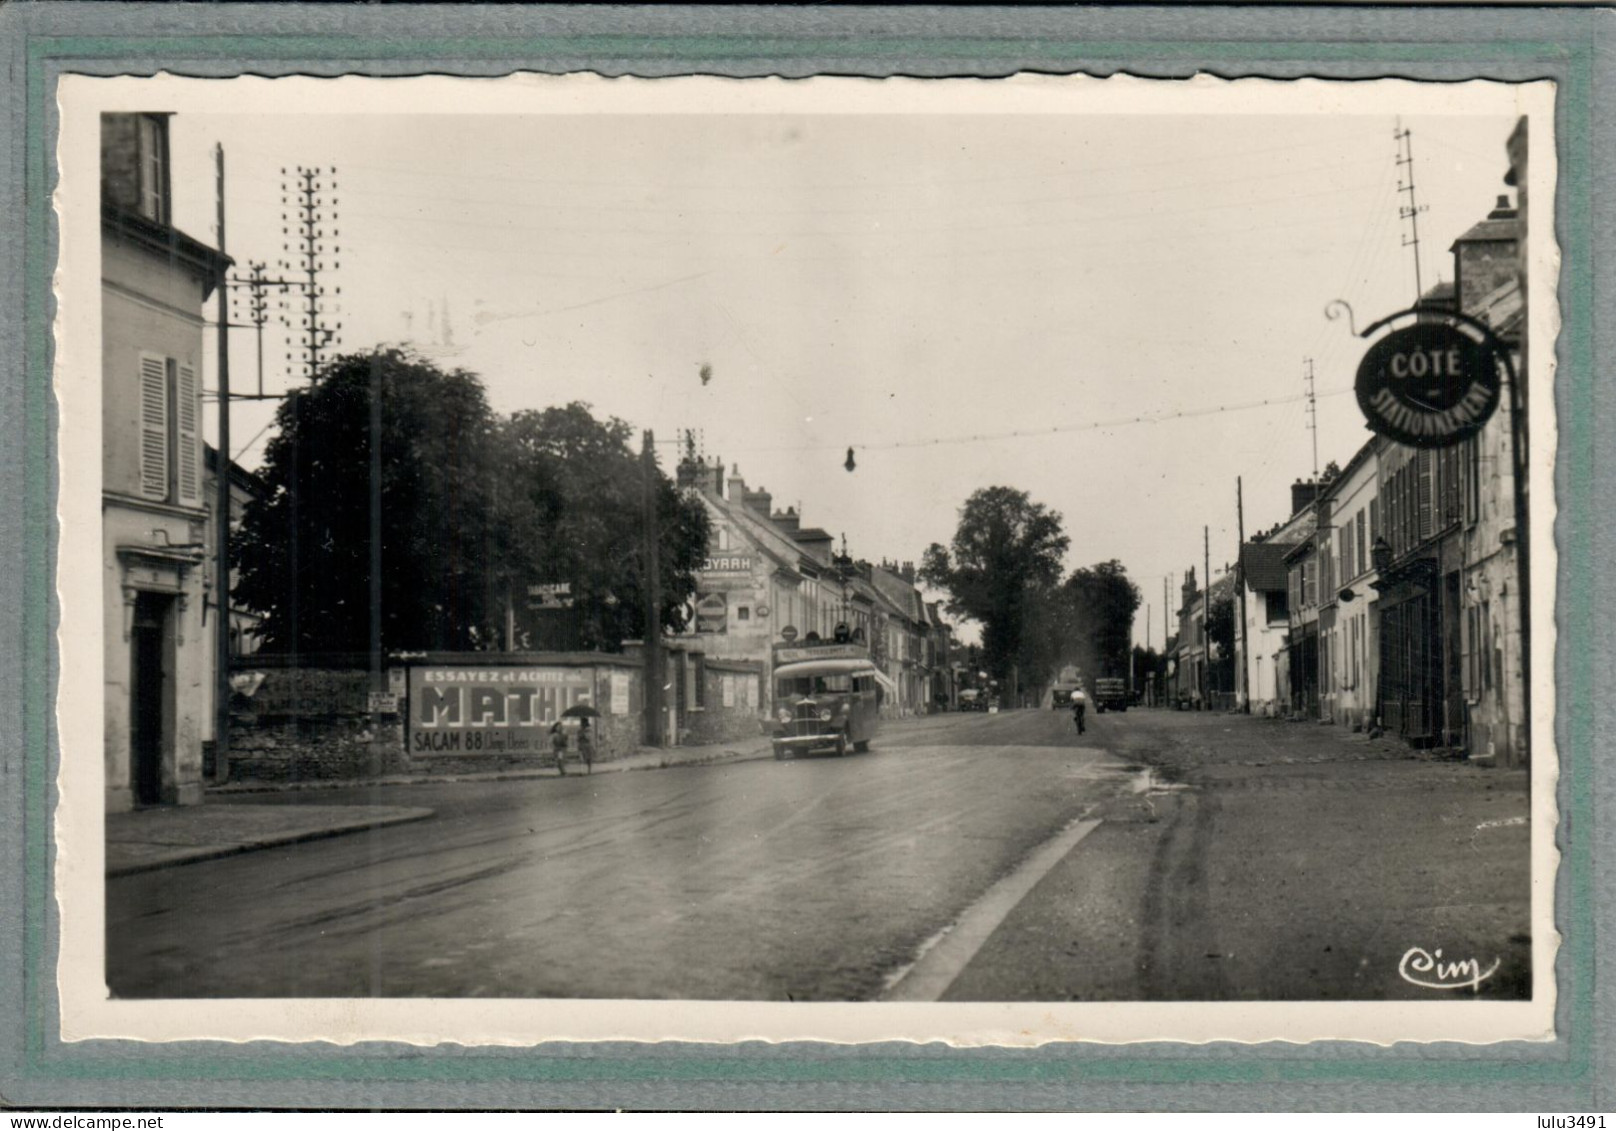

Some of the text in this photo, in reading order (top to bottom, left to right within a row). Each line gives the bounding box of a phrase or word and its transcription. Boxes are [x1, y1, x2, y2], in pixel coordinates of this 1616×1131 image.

[1369, 381, 1493, 436] STATIONNEMENT
[424, 671, 499, 682] ESSAYEZ
[415, 731, 460, 751] SACAM
[465, 731, 482, 750] 88
